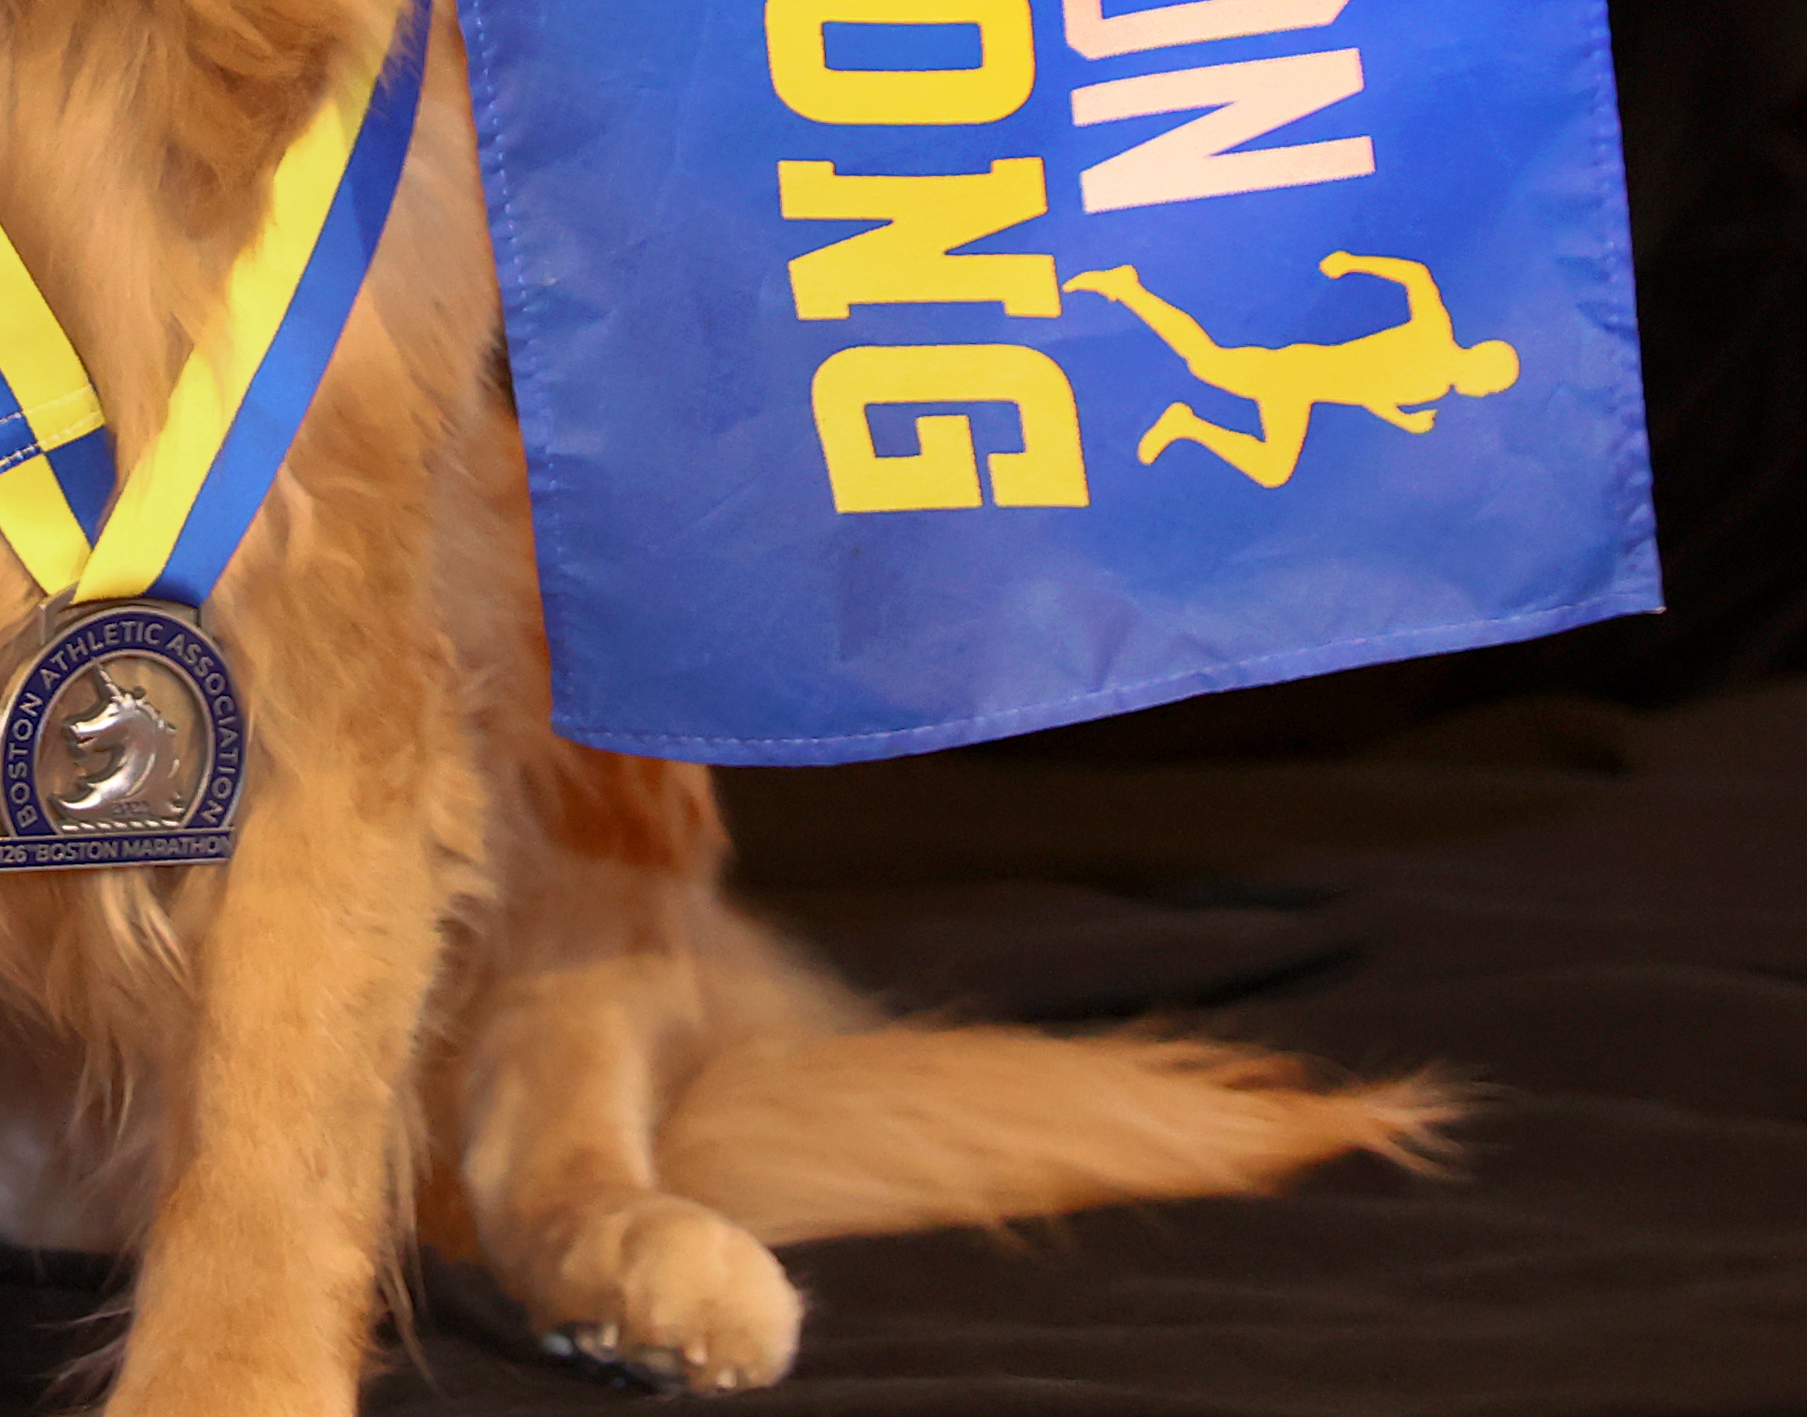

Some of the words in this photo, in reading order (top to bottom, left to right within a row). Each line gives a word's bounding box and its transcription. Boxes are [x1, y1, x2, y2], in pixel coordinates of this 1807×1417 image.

[8, 692, 43, 828] BOSTON
[40, 620, 164, 690] ATHLETIC
[165, 633, 240, 825] ASSOCIATION
[36, 840, 119, 862] BOSTON
